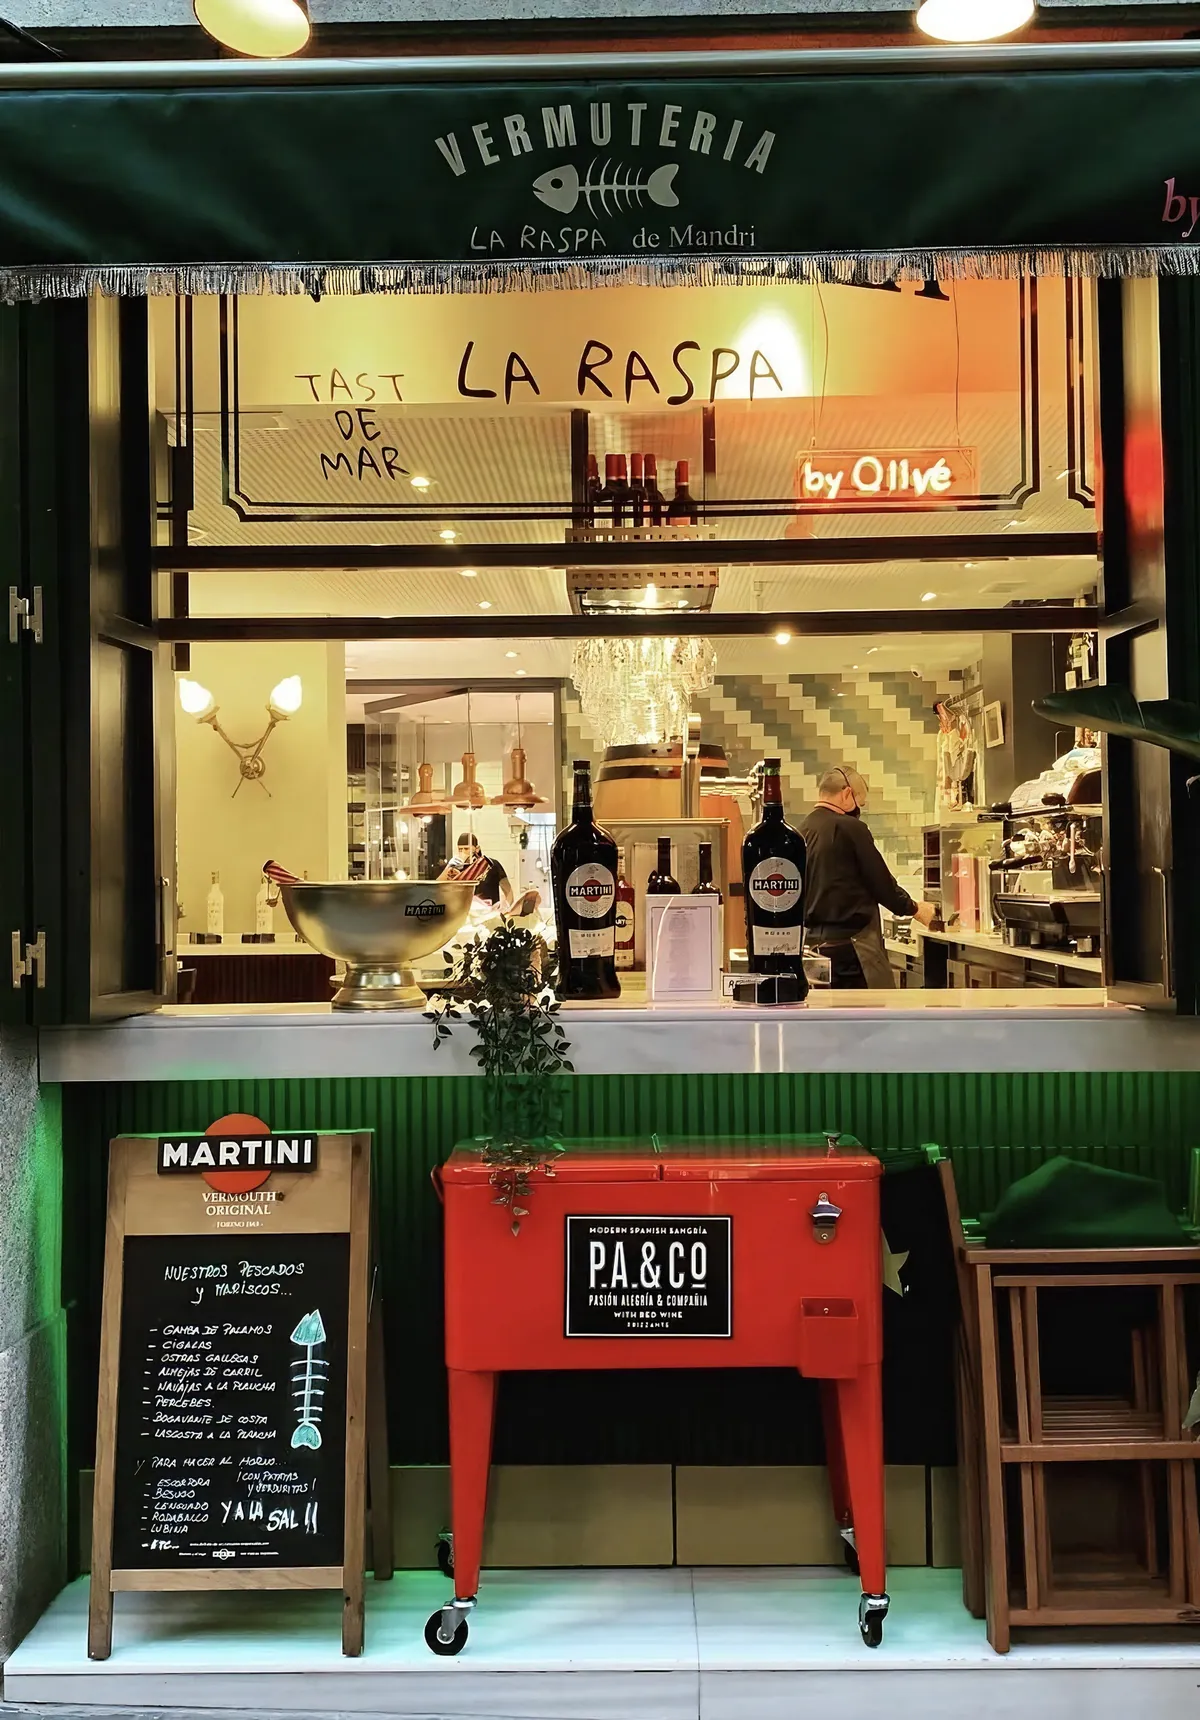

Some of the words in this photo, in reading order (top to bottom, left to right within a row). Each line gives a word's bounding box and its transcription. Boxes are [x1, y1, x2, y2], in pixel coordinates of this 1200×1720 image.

[434, 101, 776, 177] VERMUTERIA
[1162, 177, 1200, 238] by
[470, 226, 505, 251] LA
[520, 225, 607, 253] RASPA
[632, 227, 660, 249] de
[668, 225, 756, 248] Mandri
[457, 341, 541, 405] LA
[577, 339, 783, 406] RASPA
[294, 368, 405, 402] TAST
[334, 408, 381, 442] DE
[320, 446, 411, 481] MAR
[805, 461, 844, 499] by
[162, 1139, 313, 1167] MARTINI
[202, 1192, 277, 1202] VERMOUTH
[206, 1205, 271, 1216] ORIGINAL
[164, 1264, 229, 1281] NUESTROS
[238, 1260, 305, 1277] PESCADOS
[621, 1292, 654, 1306] ALEGRÍA
[657, 1294, 663, 1306] &
[162, 1324, 200, 1336] GAMBA
[222, 1322, 273, 1336] PALAMOS
[160, 1353, 201, 1363] OSTRAS
[205, 1353, 259, 1364] GALLEGAS
[222, 1367, 263, 1377] CARRIL
[216, 1381, 229, 1391] LA
[152, 1411, 213, 1424] BOGAVANTE
[238, 1414, 268, 1425] COSTA
[218, 1430, 231, 1439] LA
[151, 1456, 177, 1468] PARA
[182, 1457, 216, 1467] HACER
[218, 1456, 233, 1466] AL
[154, 1501, 209, 1511] LENGUADO
[221, 1500, 233, 1524] Y
[234, 1501, 245, 1521] A
[248, 1501, 264, 1522] LA
